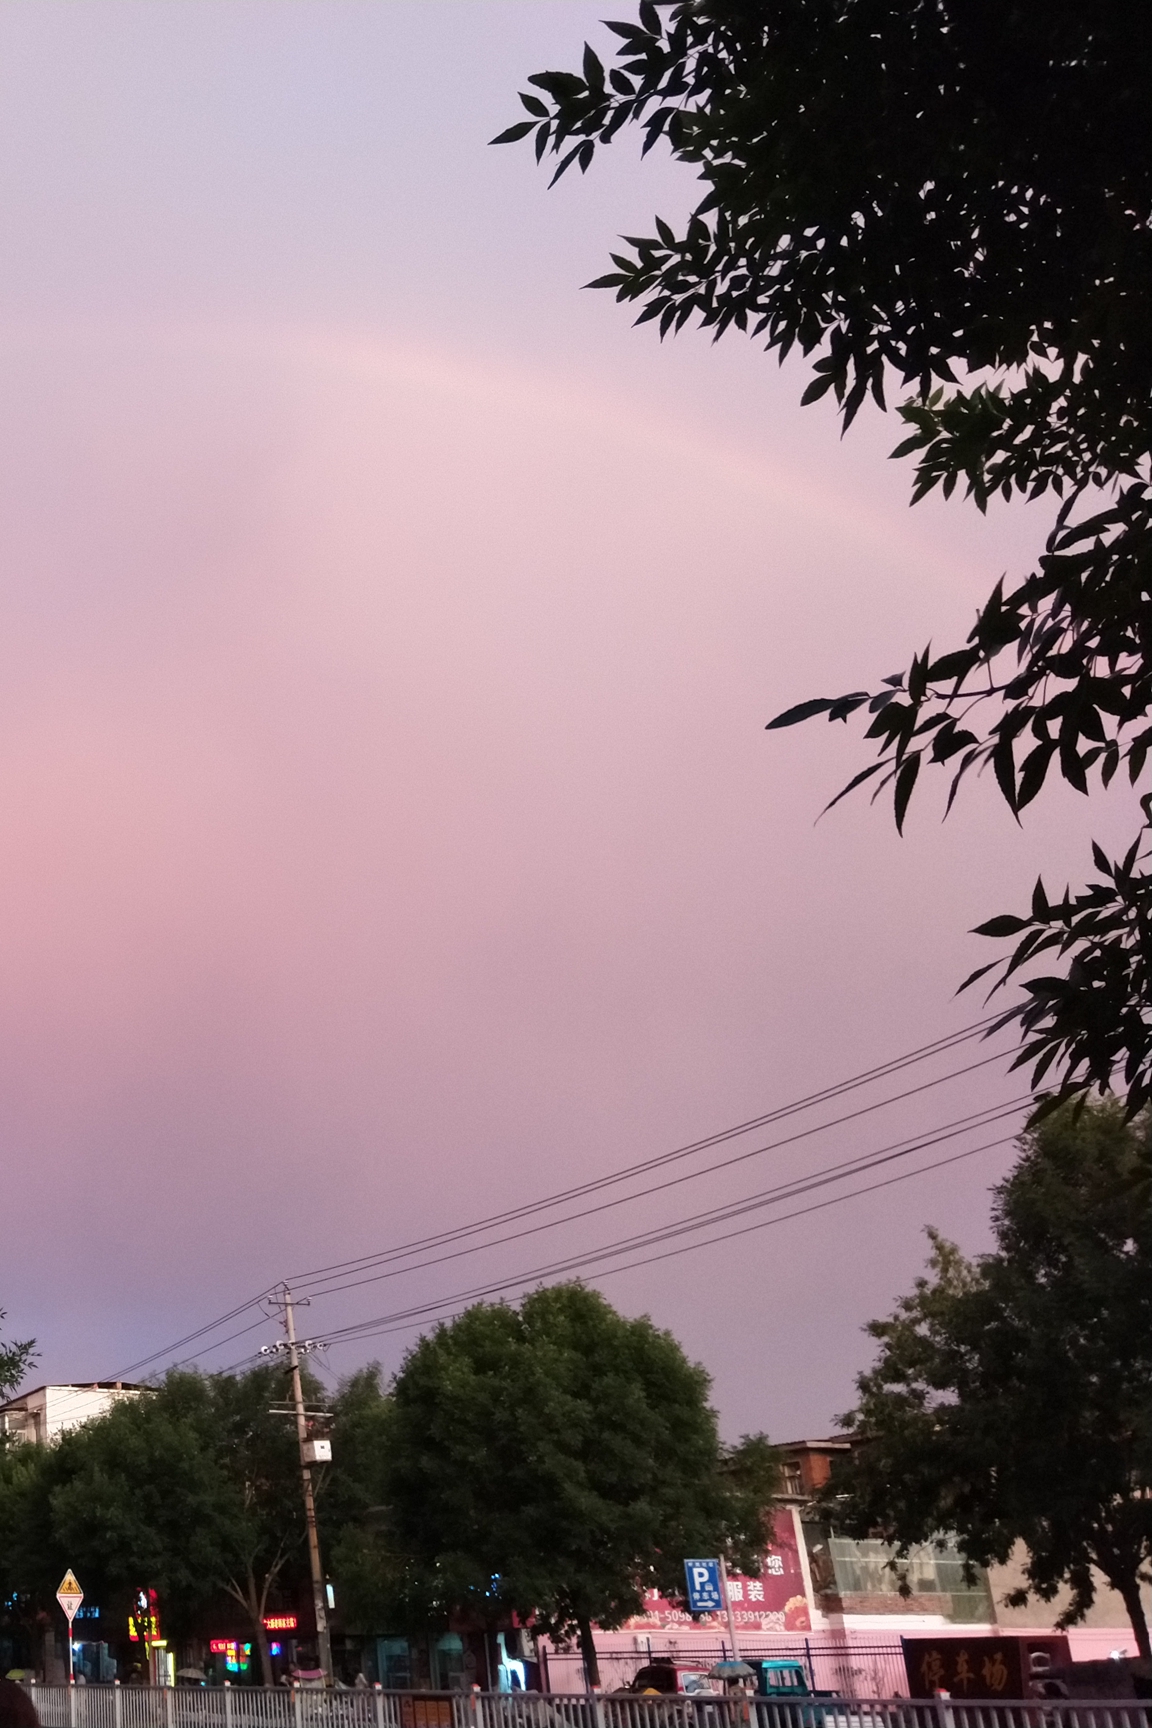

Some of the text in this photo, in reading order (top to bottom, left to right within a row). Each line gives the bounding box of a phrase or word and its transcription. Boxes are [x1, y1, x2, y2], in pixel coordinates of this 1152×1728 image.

[765, 1554, 785, 1576] 您
[692, 1567, 710, 1591] P
[726, 1580, 765, 1602] 服装
[920, 1649, 1008, 1692] 停车场
